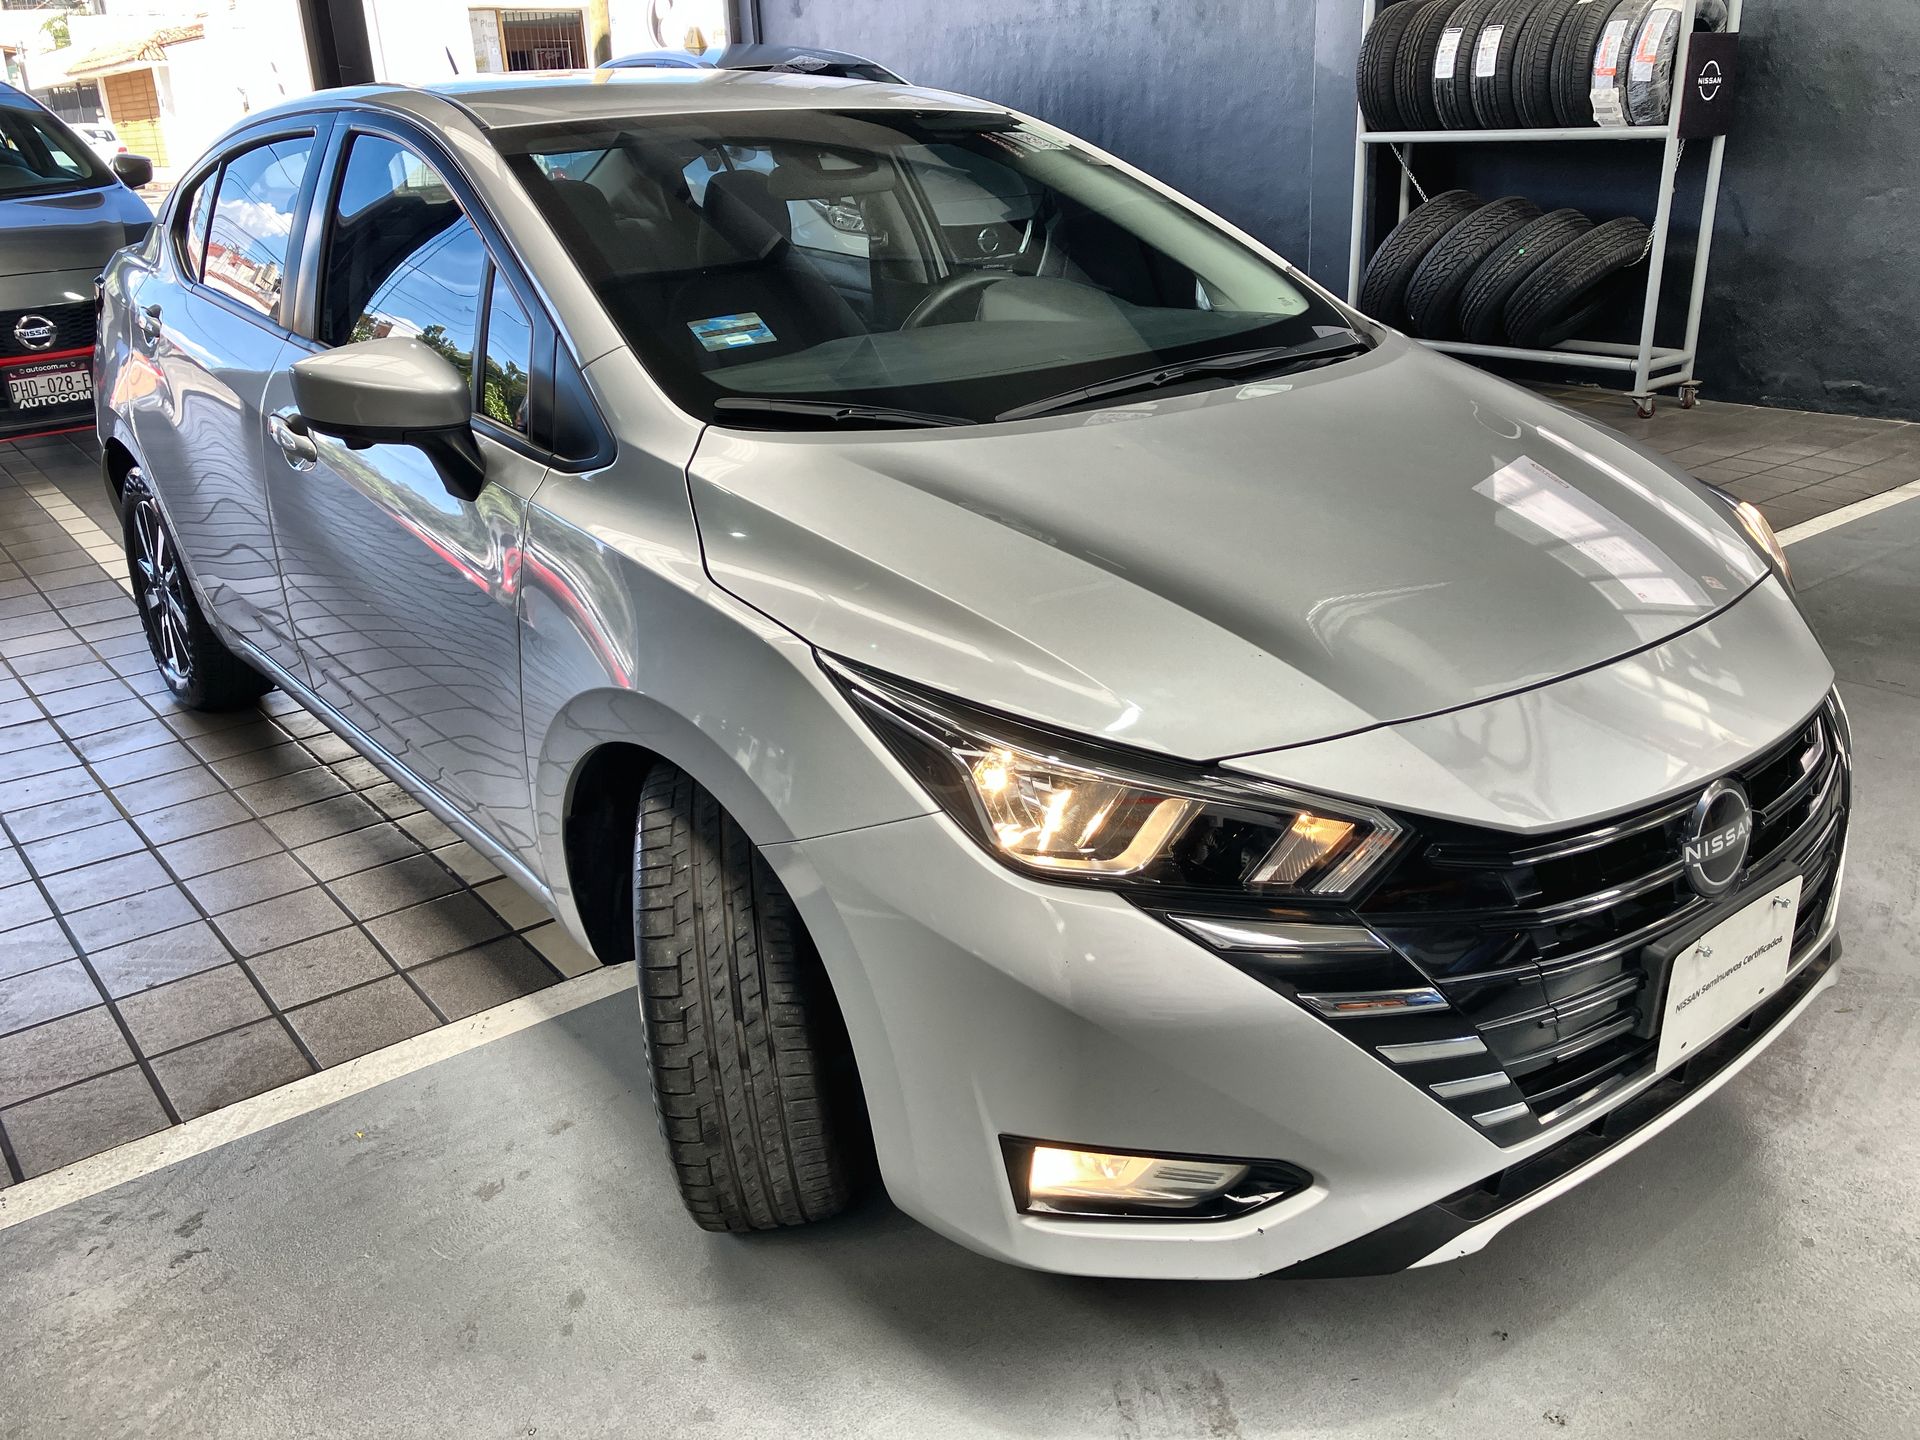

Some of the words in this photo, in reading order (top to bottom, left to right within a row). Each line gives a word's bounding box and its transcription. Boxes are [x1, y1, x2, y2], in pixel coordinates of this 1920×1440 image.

[1697, 76, 1722, 84] NISSAN
[26, 363, 68, 374] autocom.mx
[20, 390, 92, 409] AUTOCOM
[1685, 816, 1752, 862] NISSAN
[1676, 988, 1701, 1013] NISSAN
[1701, 961, 1742, 994] Seminuevos
[1743, 936, 1783, 966] Certificados
